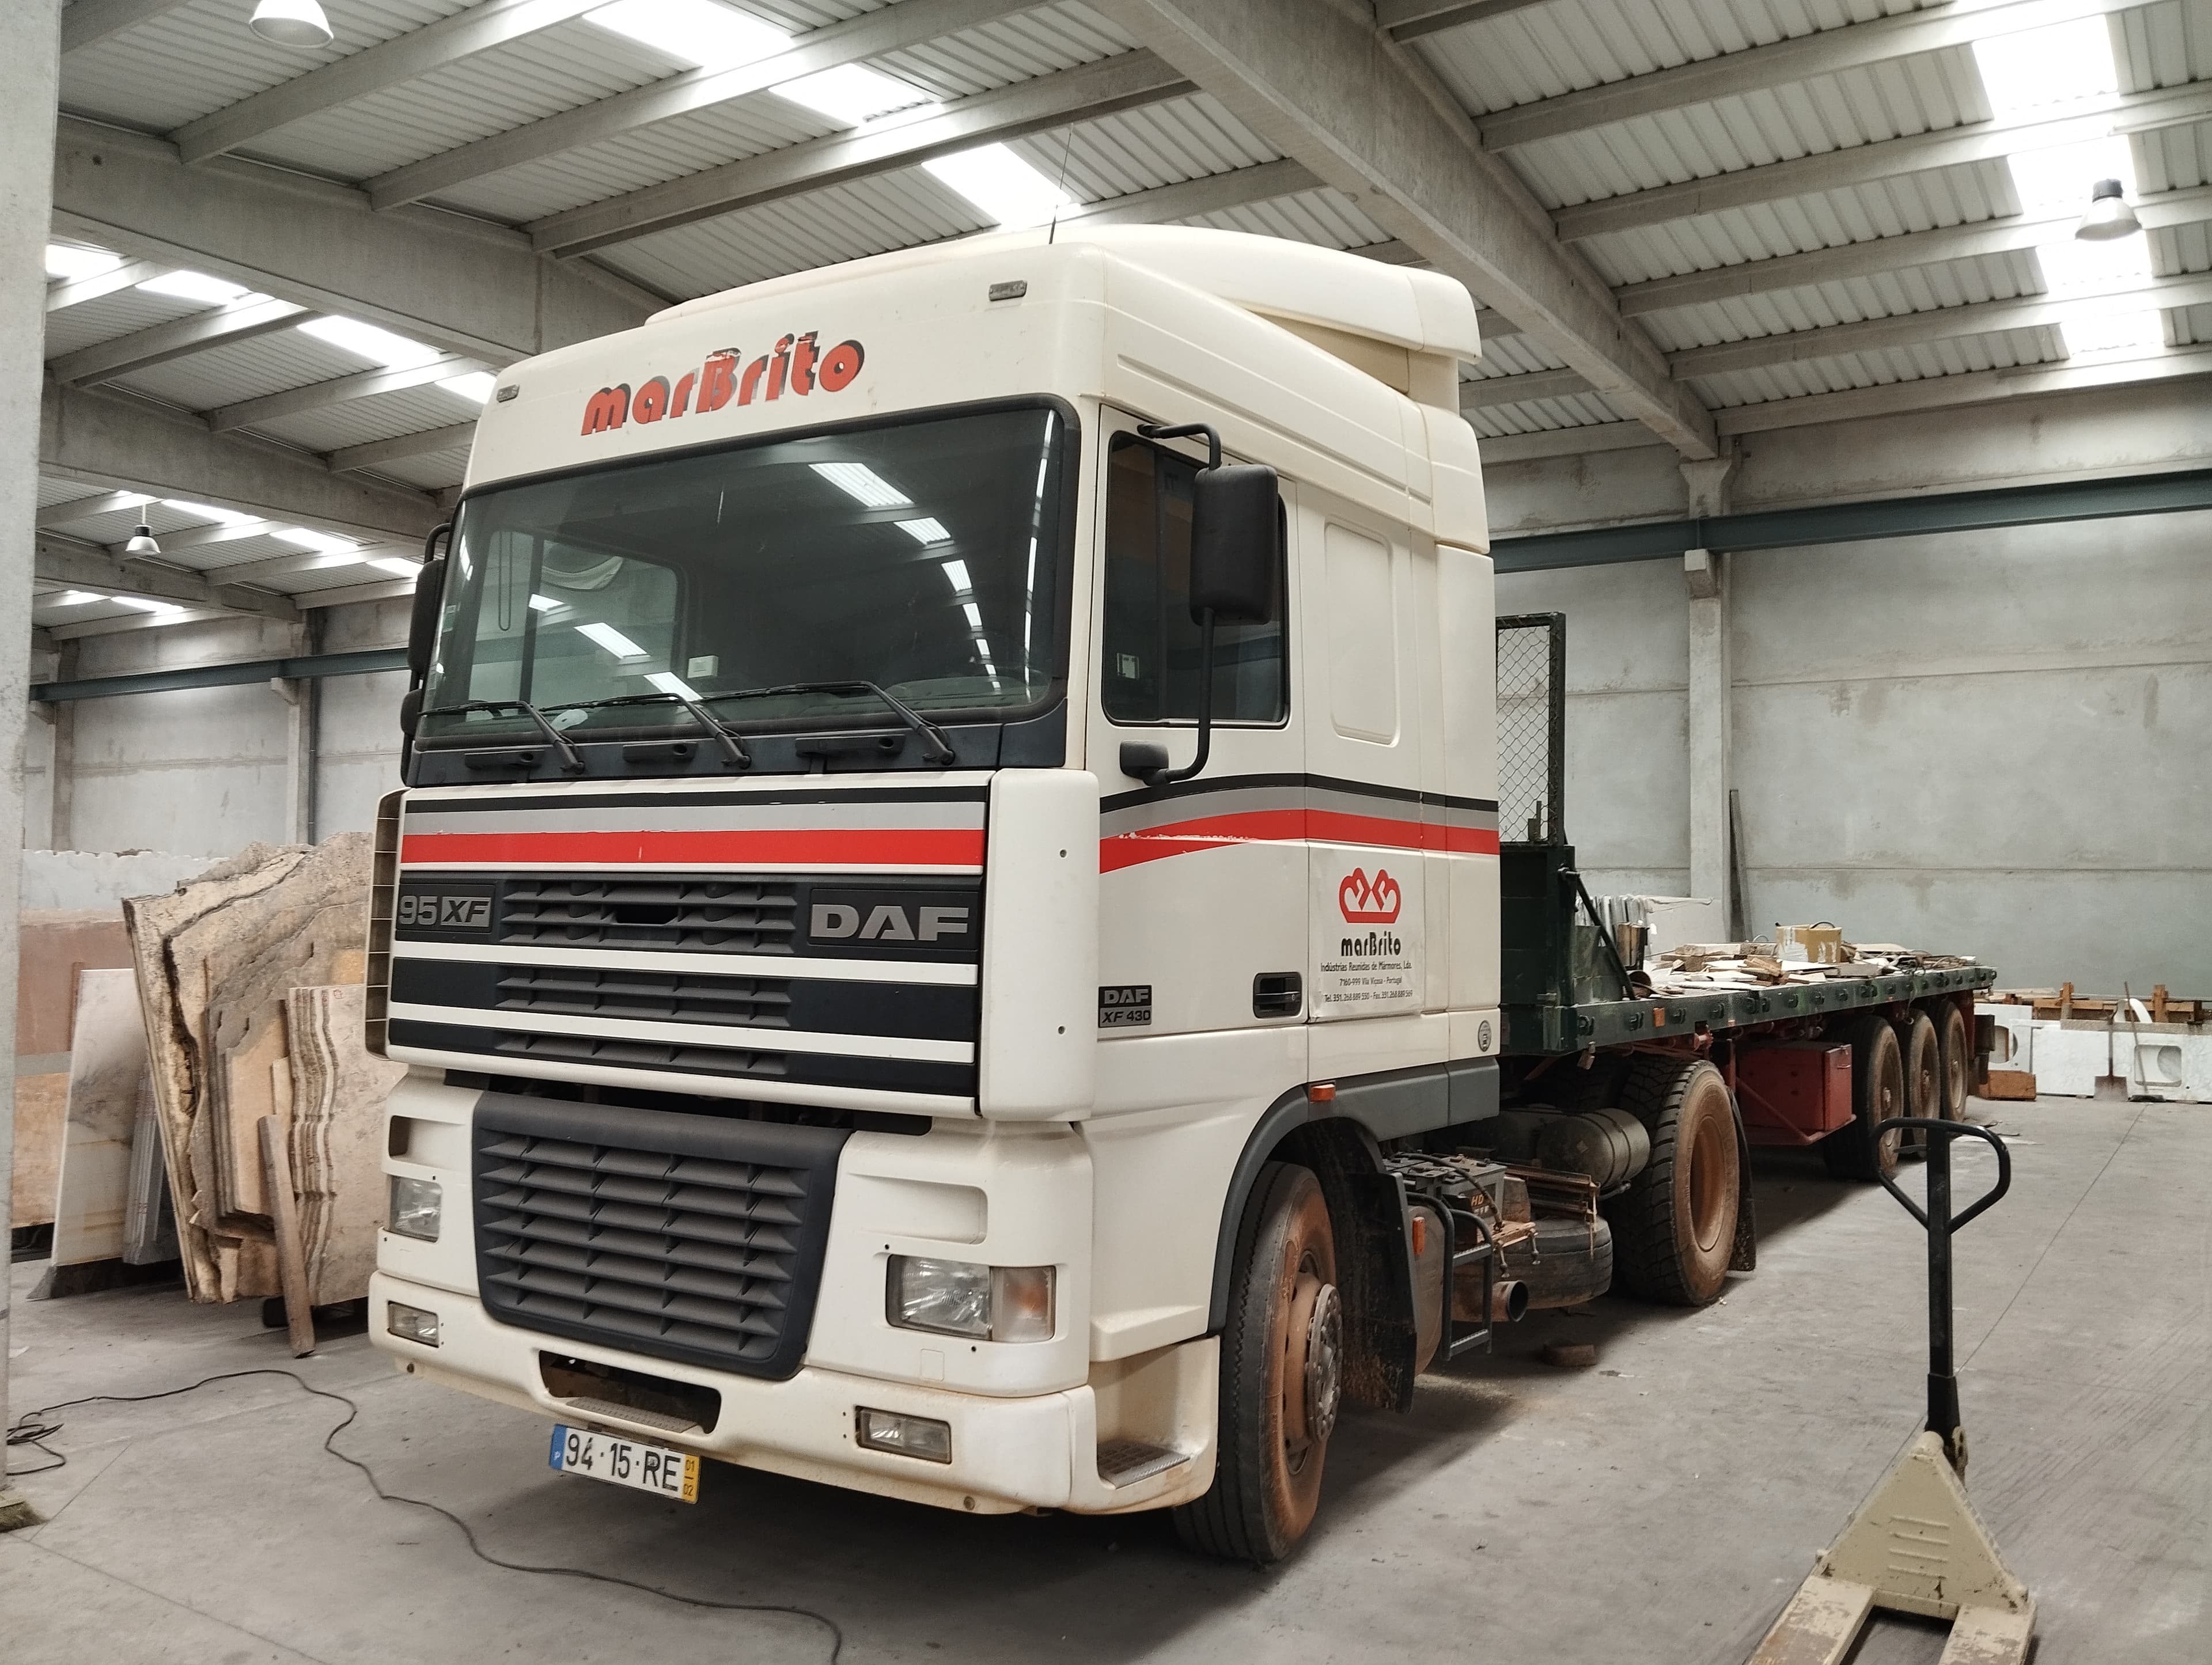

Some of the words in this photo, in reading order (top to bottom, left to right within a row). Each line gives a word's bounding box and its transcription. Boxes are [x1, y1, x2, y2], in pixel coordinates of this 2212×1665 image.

[581, 330, 865, 435] marBrito
[810, 904, 969, 941] DAF
[1341, 930, 1401, 957] marBrito
[1349, 961, 1370, 972] Reunidas
[1371, 961, 1378, 971] de
[1387, 976, 1402, 985] Portugal
[1104, 988, 1149, 1004] DAF
[1102, 1011, 1124, 1023] XF
[1126, 1010, 1151, 1022] 430
[1471, 1194, 1484, 1207] HD
